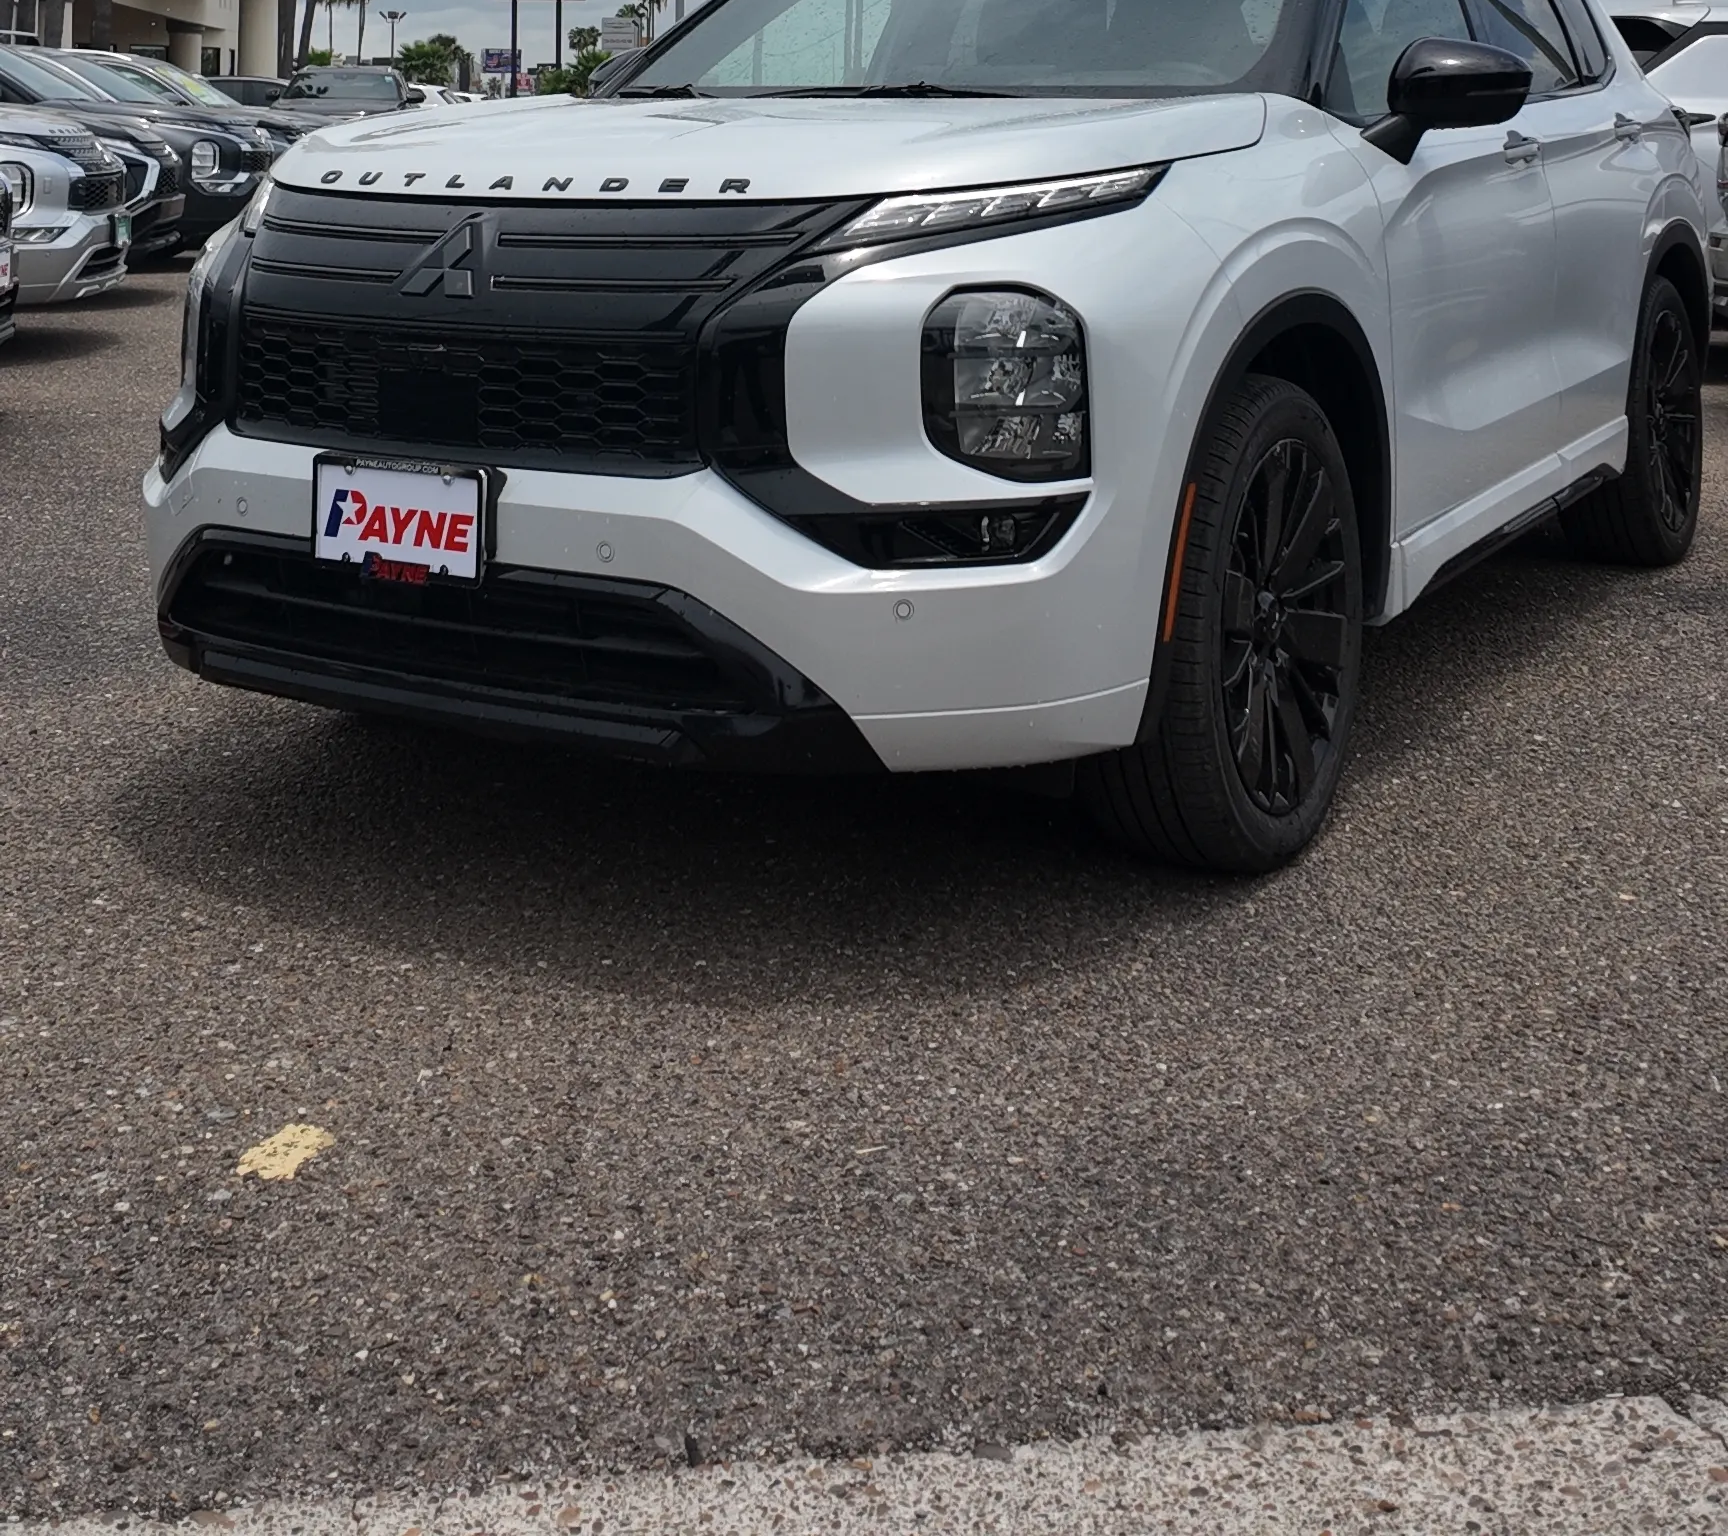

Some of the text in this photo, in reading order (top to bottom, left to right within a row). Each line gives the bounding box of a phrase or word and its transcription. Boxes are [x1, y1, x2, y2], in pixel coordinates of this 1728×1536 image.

[320, 169, 751, 194] OUTLANDER
[356, 459, 438, 473] PAYNEAUTOGROUP.COM
[324, 489, 474, 552] PAYNE
[363, 551, 429, 583] PAYNE
